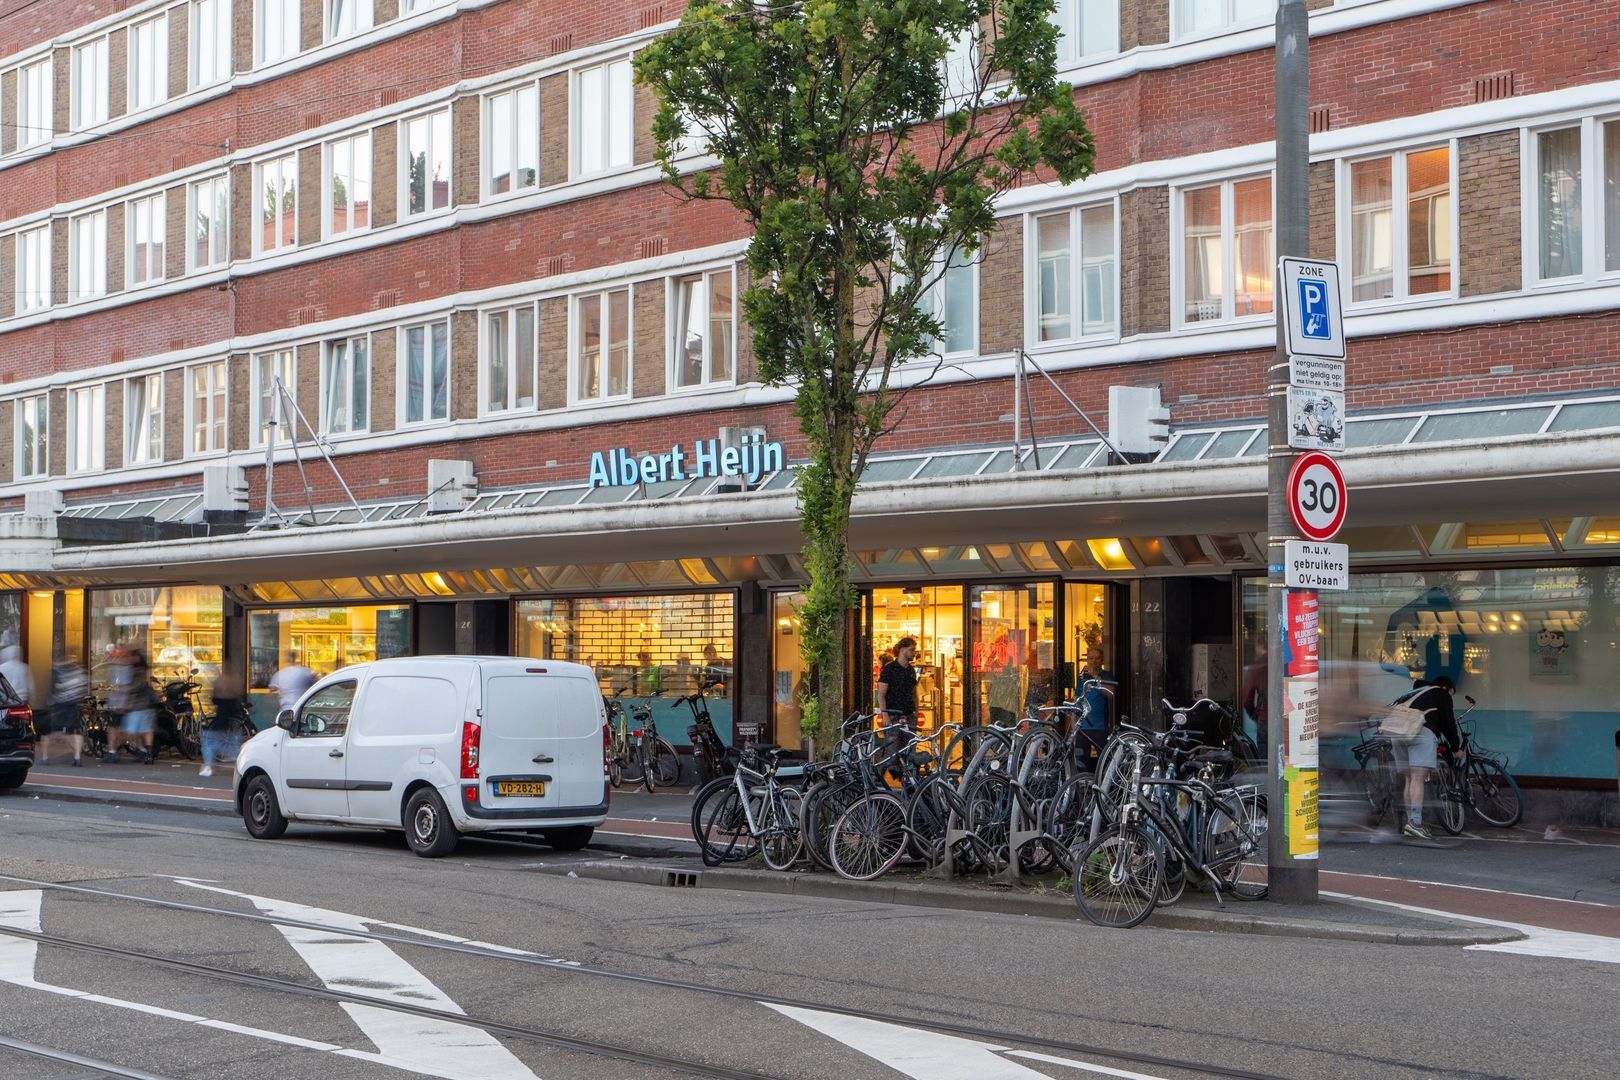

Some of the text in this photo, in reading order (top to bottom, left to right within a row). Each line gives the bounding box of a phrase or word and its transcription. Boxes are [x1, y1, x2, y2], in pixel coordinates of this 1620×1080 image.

[1299, 266, 1323, 276] ZONE
[1305, 285, 1320, 313] P
[1296, 360, 1342, 370] vergunningen
[1310, 371, 1330, 380] geldig
[589, 434, 786, 488] Albert Heijn
[1302, 479, 1336, 514] 30
[1302, 545, 1330, 555] m.u.v.
[1294, 560, 1343, 571] gebruikers
[1299, 574, 1338, 586] OV-baan
[1144, 602, 1160, 612] 22
[500, 784, 542, 793] VD-282-H
